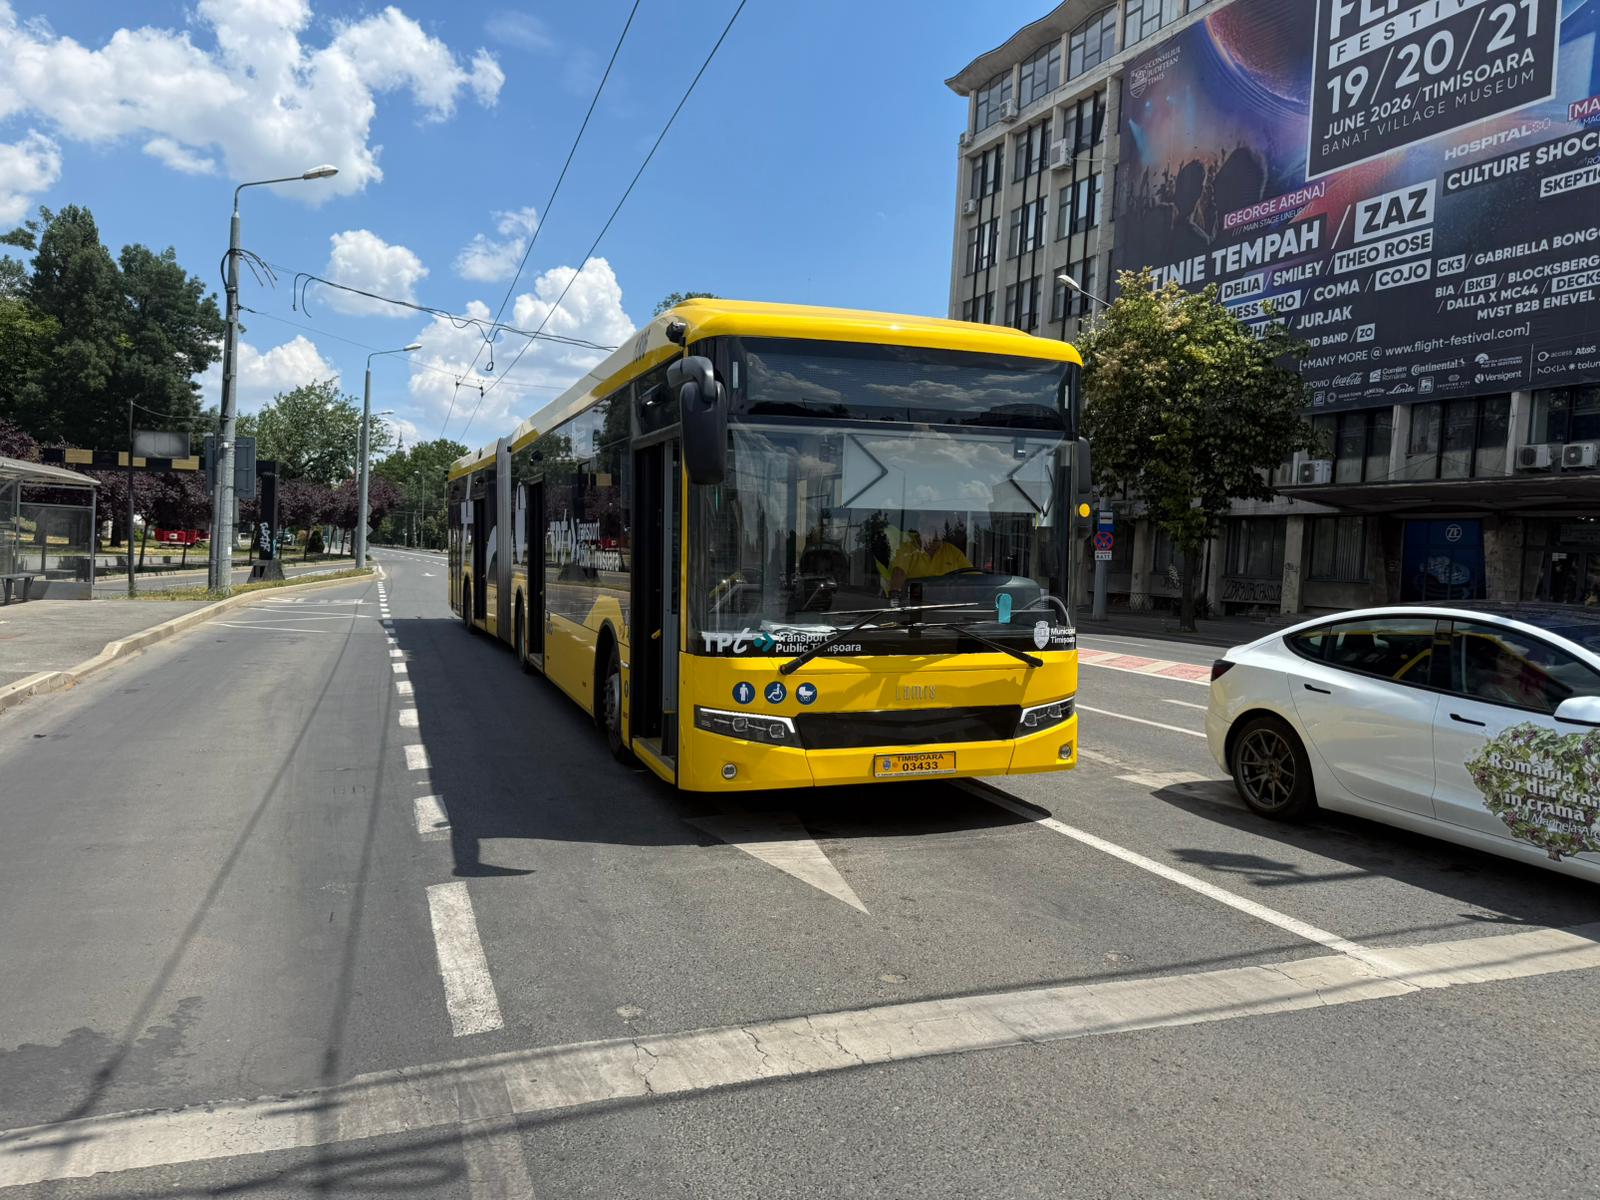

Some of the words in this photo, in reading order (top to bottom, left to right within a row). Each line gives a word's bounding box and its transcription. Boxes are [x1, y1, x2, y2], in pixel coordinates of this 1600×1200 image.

[1322, 128, 1370, 156] BANAT
[1377, 103, 1446, 136] VILLAGE
[1455, 69, 1535, 109] MUSEUM
[1324, 109, 1365, 140] JUNE
[1447, 151, 1531, 190] CULTURE
[1535, 131, 1600, 166] SHOC
[1223, 199, 1276, 229] [GEORGE
[1279, 183, 1326, 210] ARENA]
[1243, 222, 1259, 233] MAIN
[1260, 214, 1280, 228] STAGE
[1150, 255, 1206, 291] TINIE
[1211, 220, 1320, 275] TEMPAH
[1362, 188, 1428, 235] ZAZ
[1438, 258, 1463, 273] CK3
[1474, 238, 1549, 265] GABRIELLA
[1552, 227, 1600, 249] BONG
[1224, 277, 1261, 298] DELIA
[1273, 260, 1324, 286] SMILEY
[1336, 247, 1380, 270] THEO
[1384, 232, 1431, 258] ROSE
[1435, 285, 1455, 298] BIA
[1507, 255, 1600, 283] BLOCKSBERG
[1314, 279, 1360, 301] COMA
[1378, 263, 1427, 286] COJO
[1446, 295, 1486, 311] DALLA
[1488, 292, 1497, 303] X
[1500, 283, 1539, 301] MC44
[1477, 305, 1512, 321] MVST
[1515, 299, 1540, 314] B2B
[1542, 289, 1596, 309] ENEVEL
[1296, 305, 1353, 330] JURJAK
[1322, 332, 1348, 346] BAND
[1360, 327, 1374, 338] ZO
[1338, 350, 1369, 364] MORE
[1411, 358, 1459, 376] Continental
[1485, 370, 1522, 381] Versigent
[1386, 383, 1416, 395] Linde
[775, 643, 808, 653] Public
[776, 632, 828, 644] Transport
[902, 761, 939, 771] 03433
[1526, 778, 1557, 798] din
[1527, 798, 1586, 822] cramă
